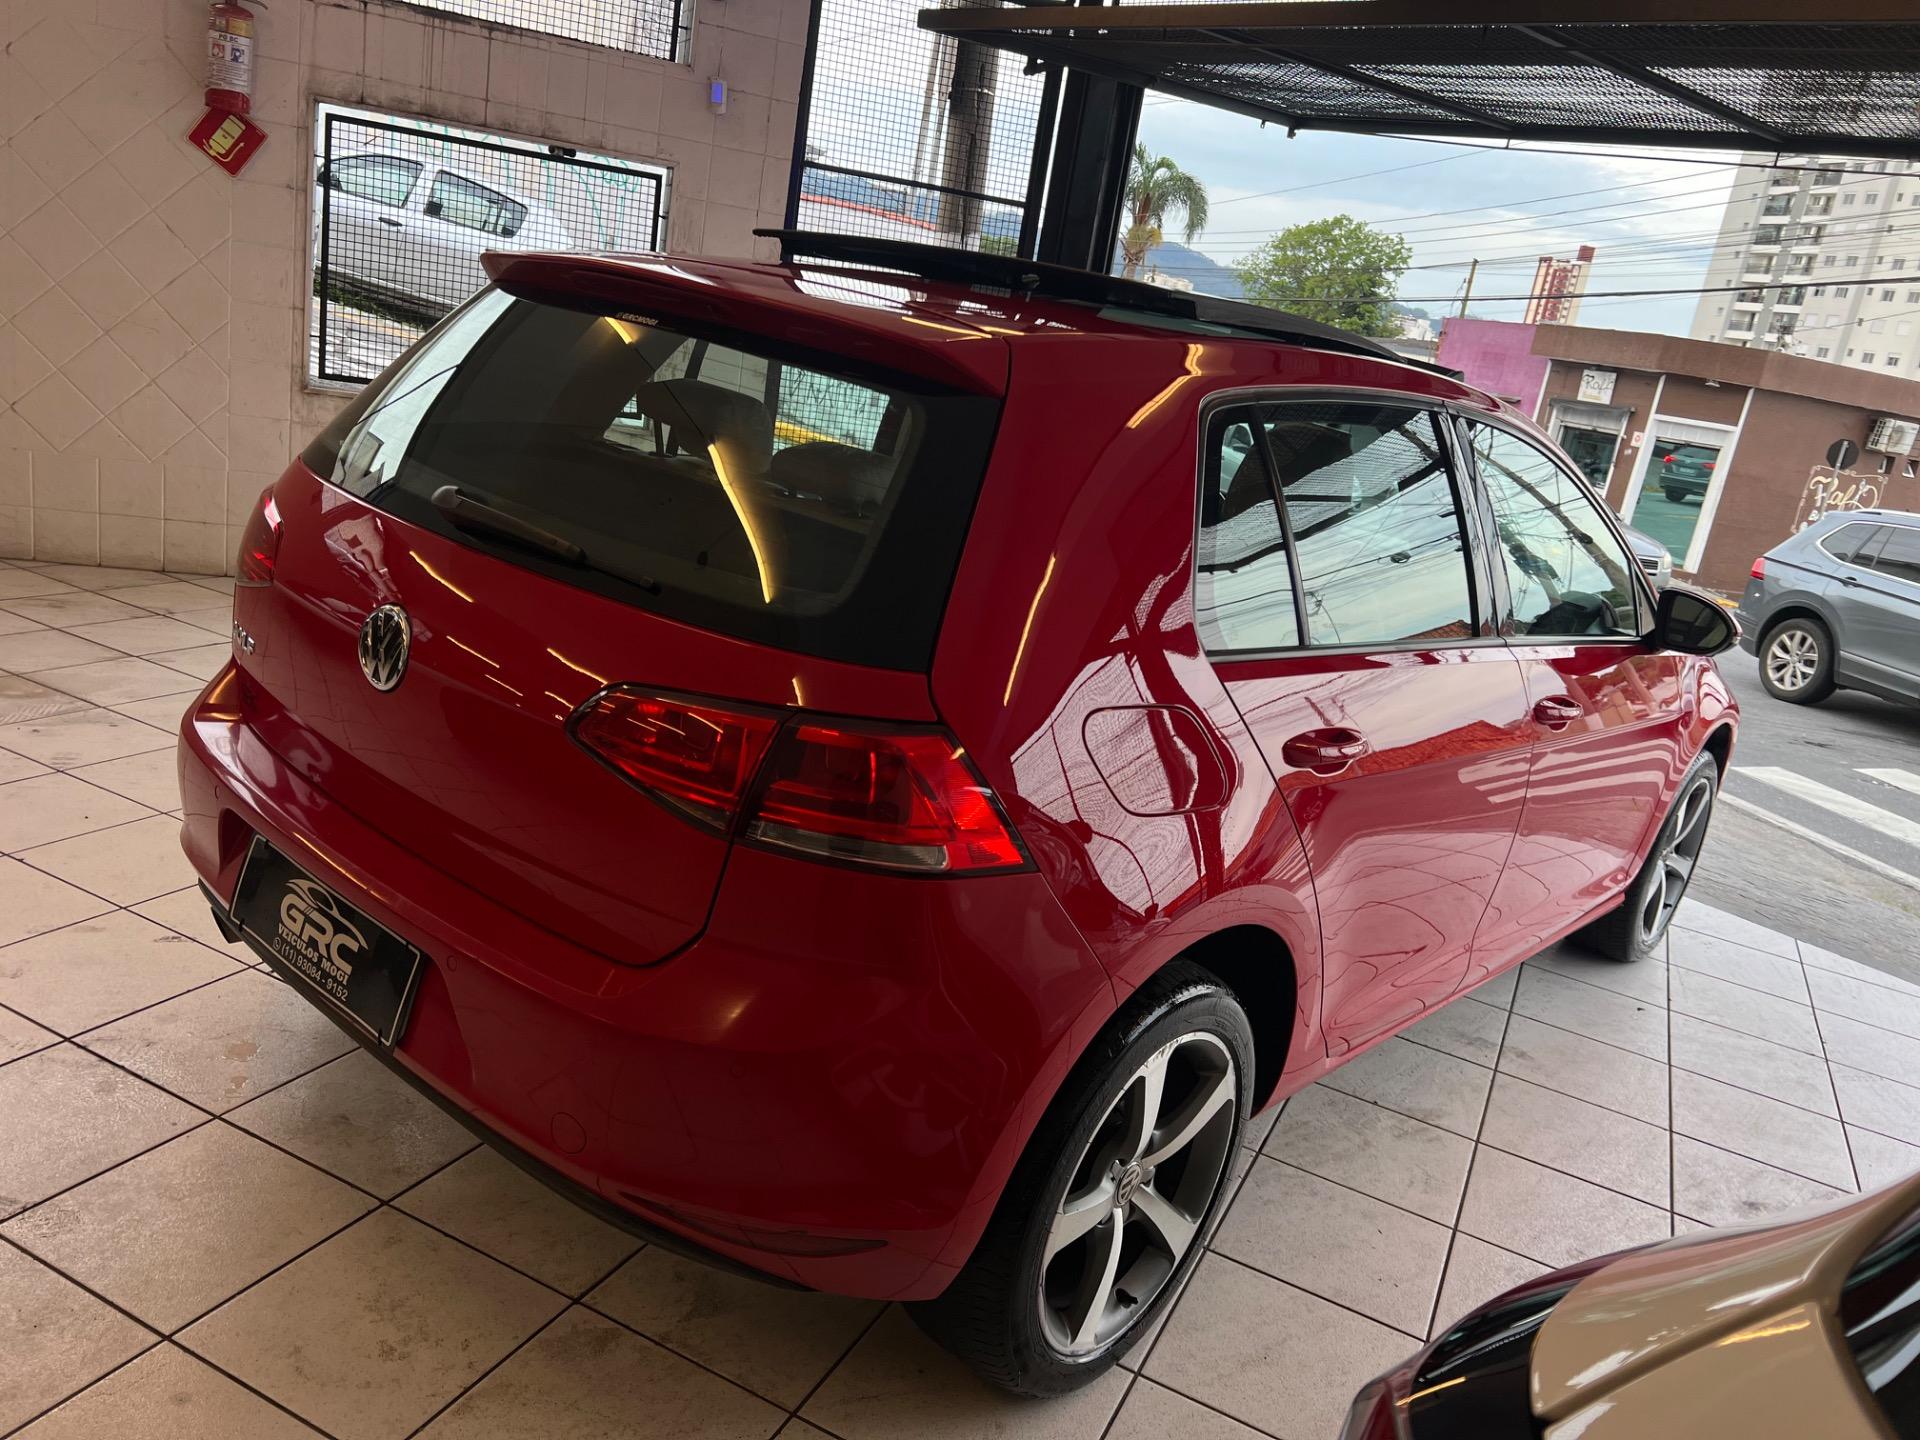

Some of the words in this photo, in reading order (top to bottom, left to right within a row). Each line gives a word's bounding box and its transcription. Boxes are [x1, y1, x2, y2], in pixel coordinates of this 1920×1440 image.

[278, 923, 319, 963] VEICULOS
[321, 956, 350, 985] MOGI
[281, 893, 360, 974] GRC
[281, 944, 297, 963] (11)
[297, 954, 321, 981] 93084
[326, 979, 349, 1002] 9152
